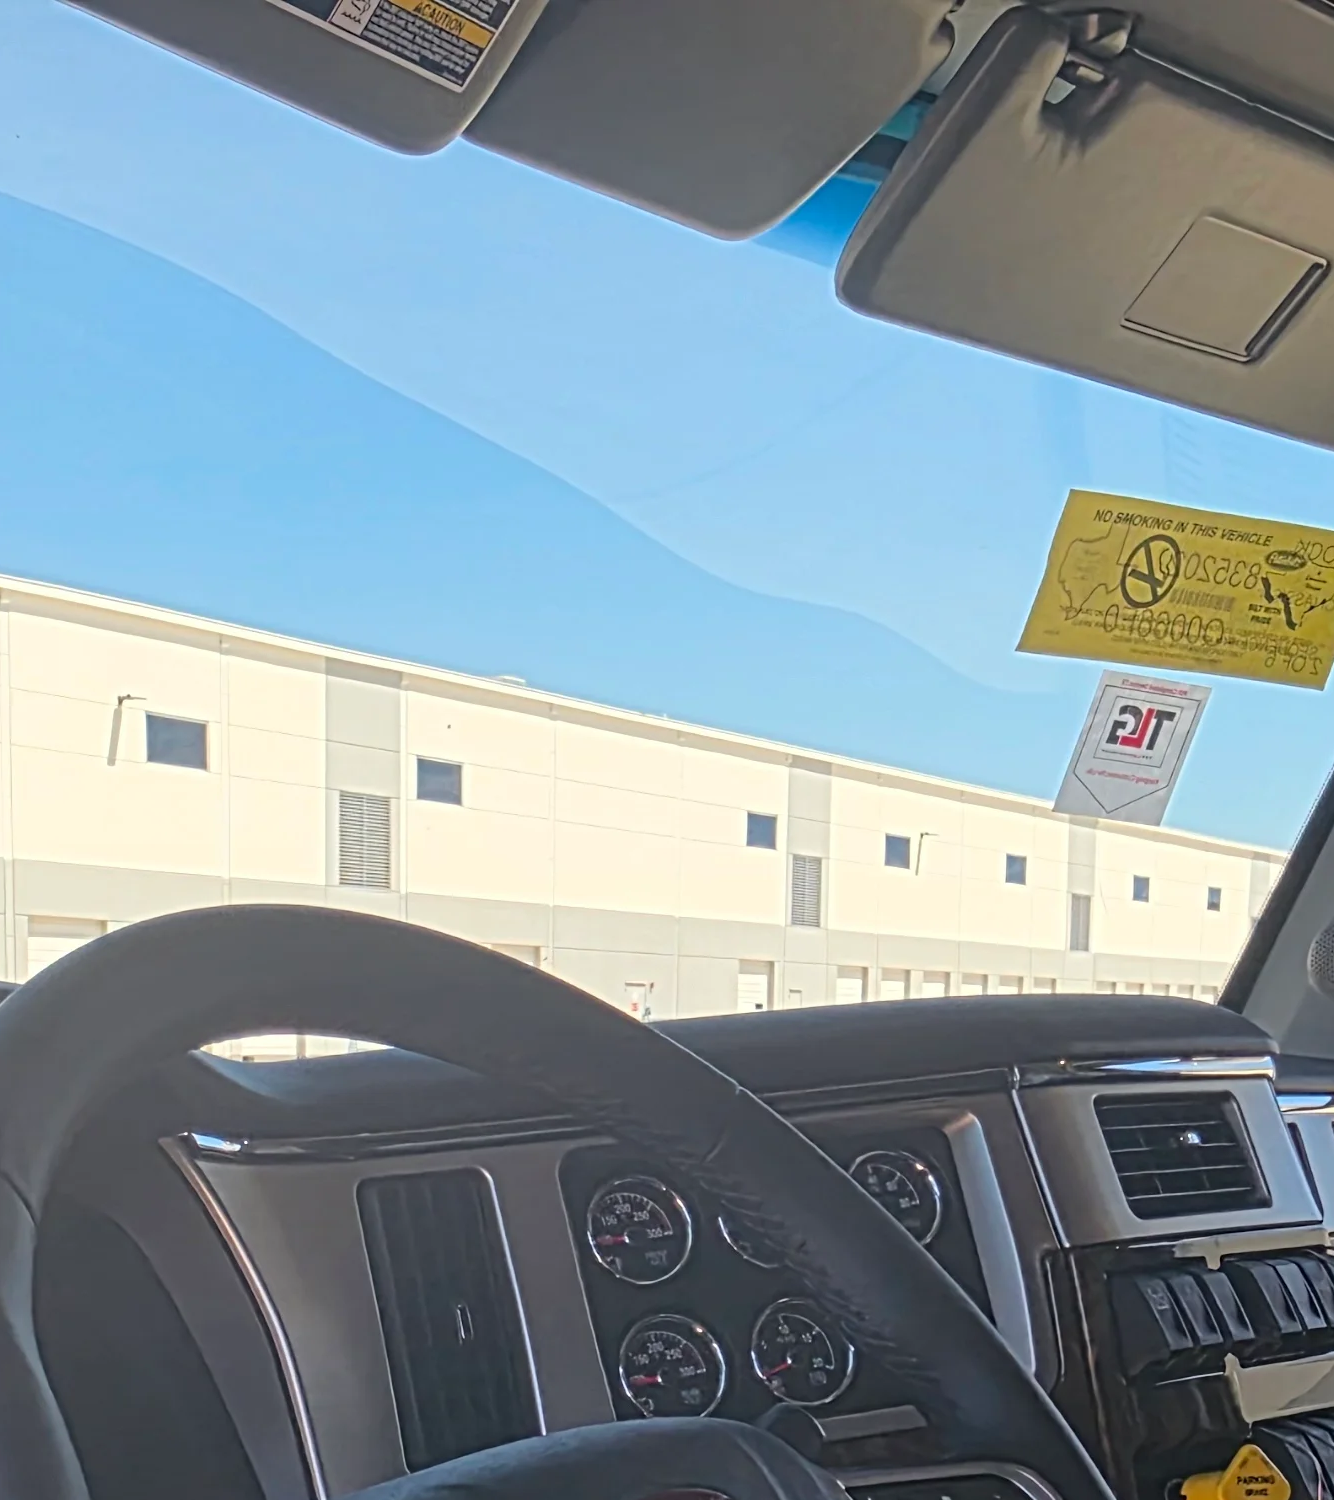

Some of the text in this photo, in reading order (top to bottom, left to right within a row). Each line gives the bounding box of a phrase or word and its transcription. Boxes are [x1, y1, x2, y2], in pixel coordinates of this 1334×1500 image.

[419, 3, 465, 33] CAUTION
[1093, 509, 1273, 547] NO SMOKING IN THIS VEHICLE
[614, 1203, 631, 1214] 200
[633, 1210, 649, 1221] 250
[646, 1227, 663, 1238] 300
[1236, 1475, 1275, 1485] PARKING
